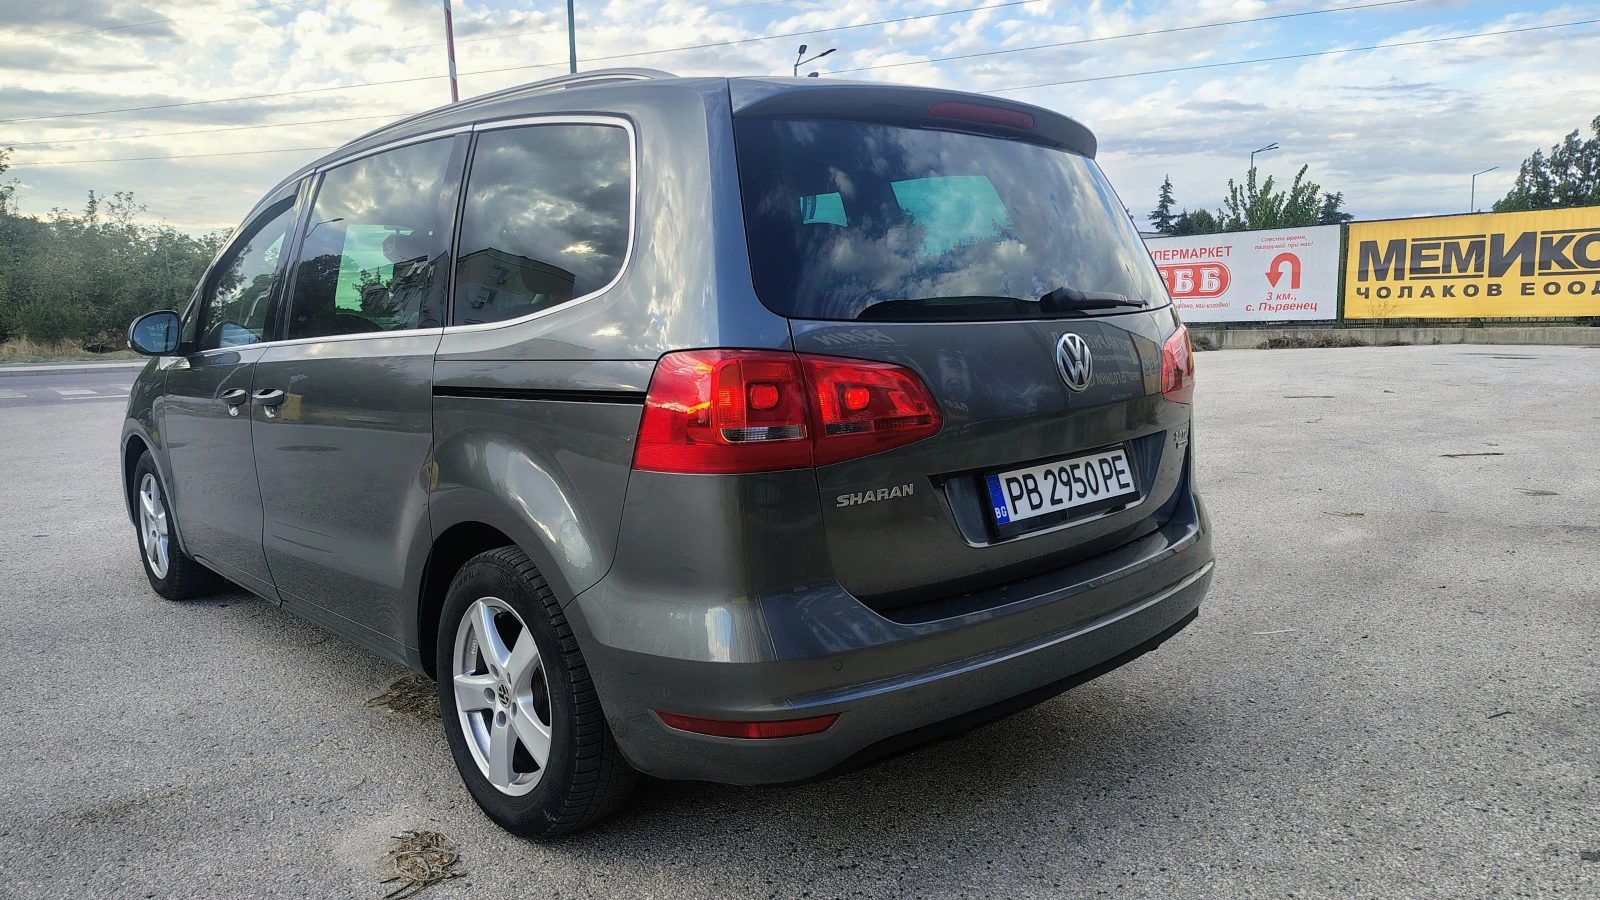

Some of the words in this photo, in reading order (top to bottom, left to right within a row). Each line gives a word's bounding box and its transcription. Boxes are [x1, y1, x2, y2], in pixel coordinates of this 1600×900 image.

[1266, 291, 1273, 301] 3
[1356, 283, 1502, 299] ЧОЛАКОВ
[1245, 304, 1255, 312] с.
[1258, 302, 1318, 313] Първенец
[1005, 474, 1043, 515] PB
[1043, 461, 1100, 507] 2950
[1098, 454, 1131, 493] PE
[836, 483, 914, 507] SHARAN
[995, 505, 1008, 519] BG
